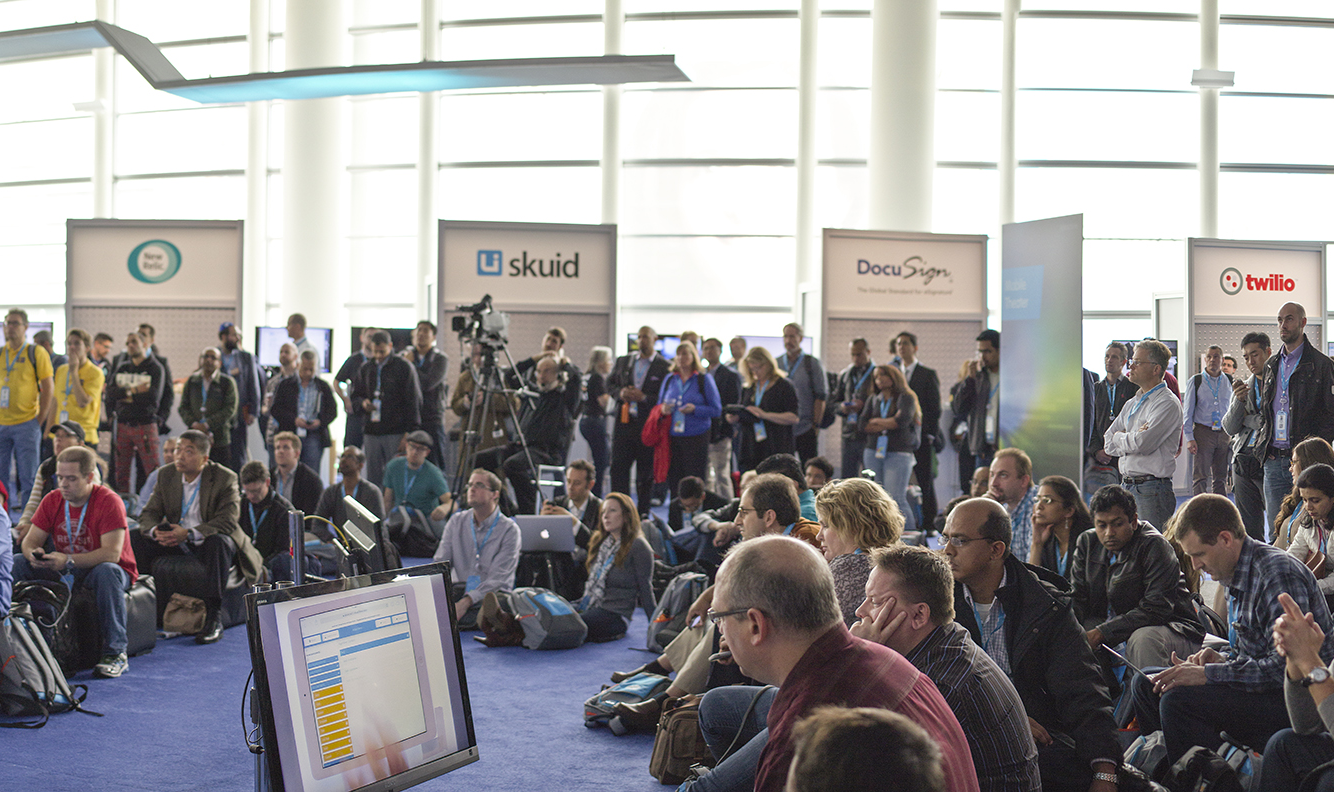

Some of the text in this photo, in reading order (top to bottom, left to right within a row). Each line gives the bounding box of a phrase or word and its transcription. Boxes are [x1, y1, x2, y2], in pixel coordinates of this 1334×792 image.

[508, 250, 580, 278] skuid
[857, 255, 952, 286] DocuSign
[1245, 273, 1296, 292] twilio
